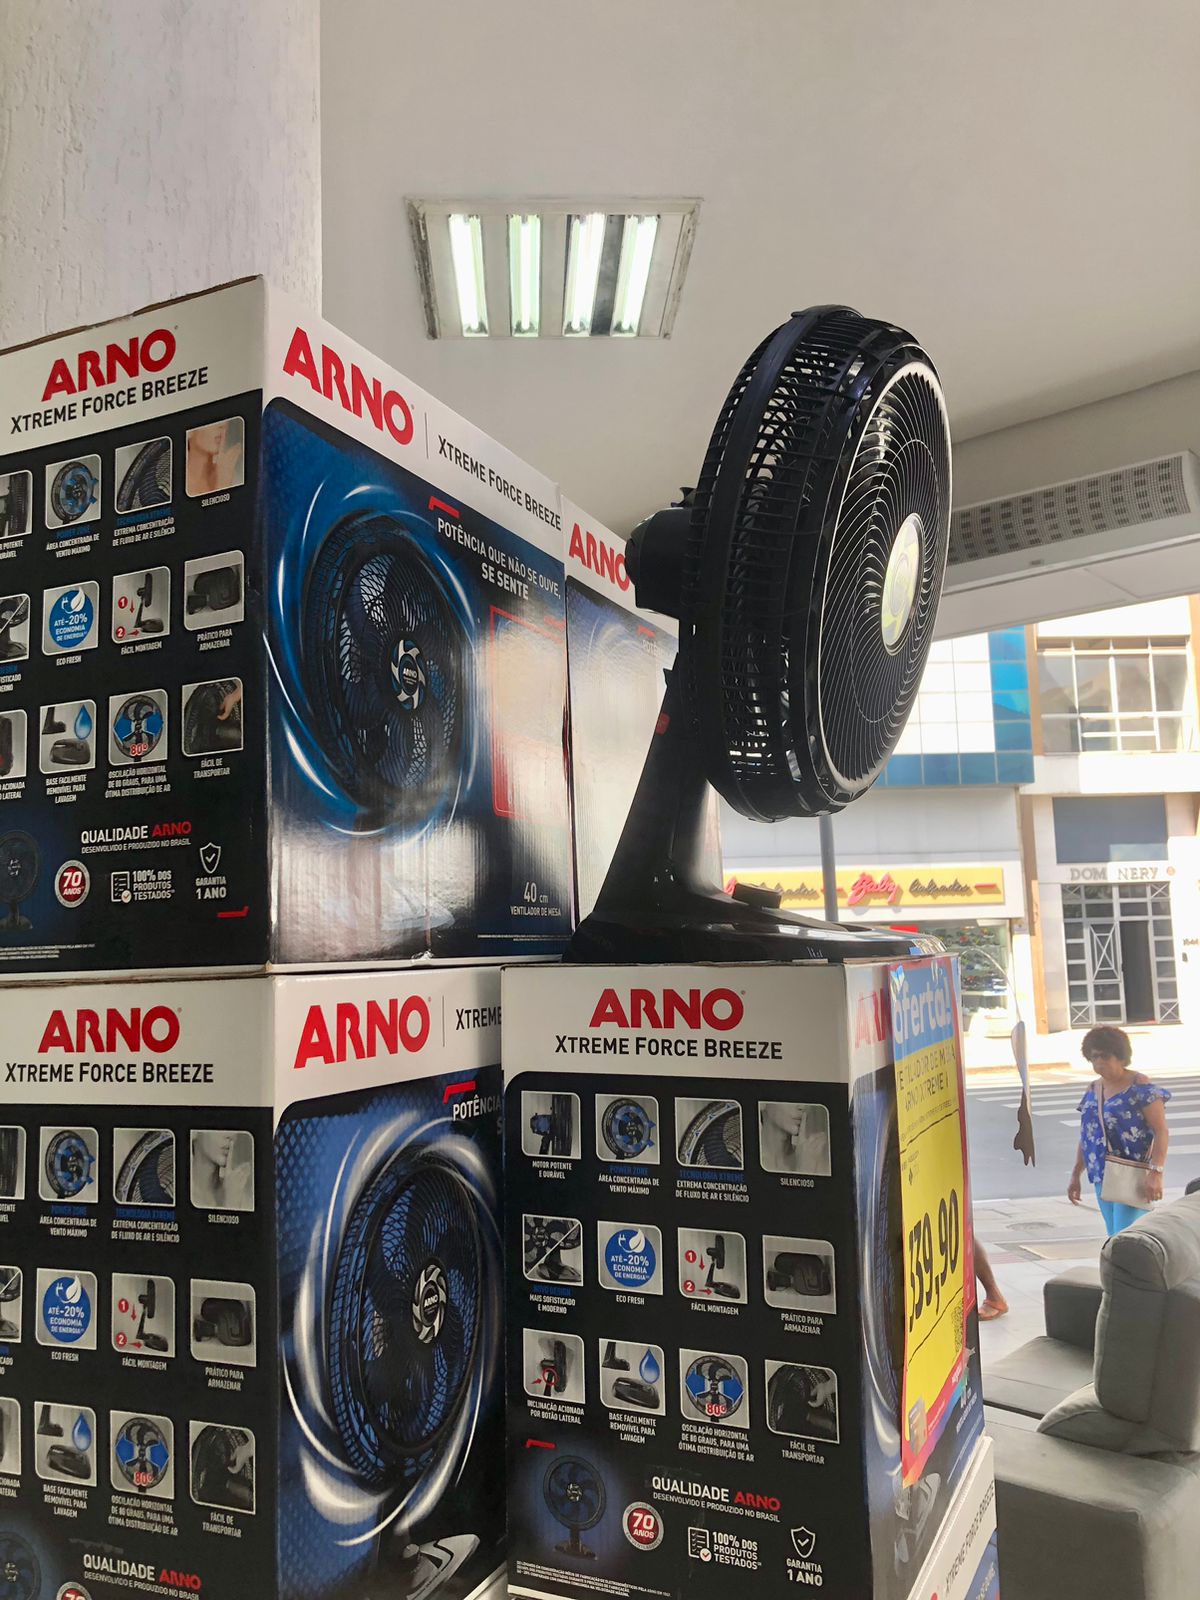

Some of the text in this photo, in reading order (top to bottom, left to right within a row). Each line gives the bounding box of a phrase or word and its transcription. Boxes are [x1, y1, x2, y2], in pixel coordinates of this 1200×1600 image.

[42, 328, 177, 401] ARNO
[11, 367, 208, 434] XTREME FORCE BREEZE
[283, 327, 562, 532] ARNO XTREME FORCE BREEZE
[201, 494, 230, 507] SILENCIOSO
[114, 526, 136, 537] EXTREMA
[438, 517, 562, 600] POTÊNCIA QUE NÃO SE OUVE,
[568, 522, 630, 592] ARNO
[481, 562, 530, 601] SE SENTE
[54, 619, 65, 627] ATÉ
[55, 626, 86, 635] ECONOMIA
[197, 628, 233, 642] PRÁTICO PARA
[121, 641, 162, 655] FÁCIL MONTAGEM
[199, 639, 230, 651] ARMAZENAR
[56, 655, 82, 666] ECO FRESH
[193, 767, 231, 779] TRANSPORTAR
[81, 821, 192, 845] QUALIDADE ARNO
[62, 871, 81, 888] 70
[132, 870, 172, 882] 100% DOS
[195, 876, 227, 886] GARANTIA
[133, 880, 171, 890] PRODUTOS
[523, 881, 537, 903] 40
[510, 905, 540, 916] VENTILADOR
[541, 906, 547, 916] DE
[589, 987, 744, 1031] ARNO
[38, 1005, 180, 1053] ARNO
[294, 995, 430, 1069] ARNO
[555, 1035, 783, 1060] XTREME FORCE BREEZE
[5, 1061, 214, 1083] XTREME FORCE BREEZE
[532, 1160, 572, 1170] MOTOR POTENTE
[598, 1174, 660, 1186] ÁREA CONCENTRADA DE
[676, 1180, 747, 1193] EXTREMA CONCENTRAÇÃO
[780, 1178, 815, 1188] SILENCIOSO
[609, 1184, 650, 1195] VENTO MÁXIMO
[675, 1190, 684, 1198] DE
[683, 1191, 701, 1199] FLUXO
[701, 1192, 709, 1200] DE
[709, 1192, 719, 1200] AR
[723, 1192, 750, 1203] SILÊNCIO
[112, 1219, 178, 1232] EXTREMA CONCENTRAÇÃO
[208, 1214, 239, 1225] SILENCIOSO
[610, 1254, 649, 1267] ATÉ -20%
[613, 1264, 647, 1274] ECONOMIA
[529, 1294, 576, 1306] MAIS SOFISTICADO
[616, 1295, 645, 1305] ECO FRESH
[690, 1302, 739, 1315] FÁCIL MONTAGEM
[50, 1317, 83, 1327] ECONOMIA
[781, 1313, 824, 1326] PRÁTICO PARA
[784, 1323, 821, 1335] ARMAZENAR
[51, 1351, 79, 1362] ECO FRESH
[122, 1358, 167, 1371] FÁCIL MONTAGEM
[205, 1366, 244, 1380] PRÁTICO PARA
[207, 1378, 241, 1391] ARMAZENAR
[527, 1399, 584, 1416] INCLINAÇÃO ACIONADA
[530, 1409, 581, 1424] POR BOTÃO LATERAL
[608, 1412, 657, 1427] BASE FACILMENTE
[609, 1422, 656, 1436] REMOVÍVEL PARA
[681, 1423, 749, 1442] OSCILAÇÃO HORIZONTAL
[620, 1433, 645, 1444] LAVAGEM
[681, 1433, 689, 1442] DE
[719, 1439, 735, 1449] PARA
[735, 1441, 750, 1451] UMA
[678, 1441, 755, 1463] ÓTIMA DISTRIBUIÇÃO DE AR
[789, 1440, 816, 1453] FÁCIL DE
[781, 1450, 825, 1465] TRANSPORTAR
[43, 1484, 88, 1499] BASE FACILMENTE
[652, 1476, 782, 1511] QUALIDADE ARNO
[111, 1495, 140, 1508] OSCILAÇÃO
[653, 1491, 700, 1508] DESENVOLVIDO
[706, 1502, 744, 1516] PRODUZIDO
[744, 1509, 755, 1517] NO
[755, 1510, 780, 1523] BRASIL
[54, 1506, 78, 1518] LAVAGEM
[632, 1511, 655, 1530] 70
[202, 1521, 242, 1538] TRANSPORTAR
[632, 1528, 655, 1539] ANOS
[712, 1531, 758, 1551] 100% DOS
[713, 1544, 758, 1560] PRODUTOS
[786, 1557, 822, 1573] GARANTIA
[83, 1553, 202, 1591] QUALIDADE ARNO
[796, 1570, 823, 1587] ANO
